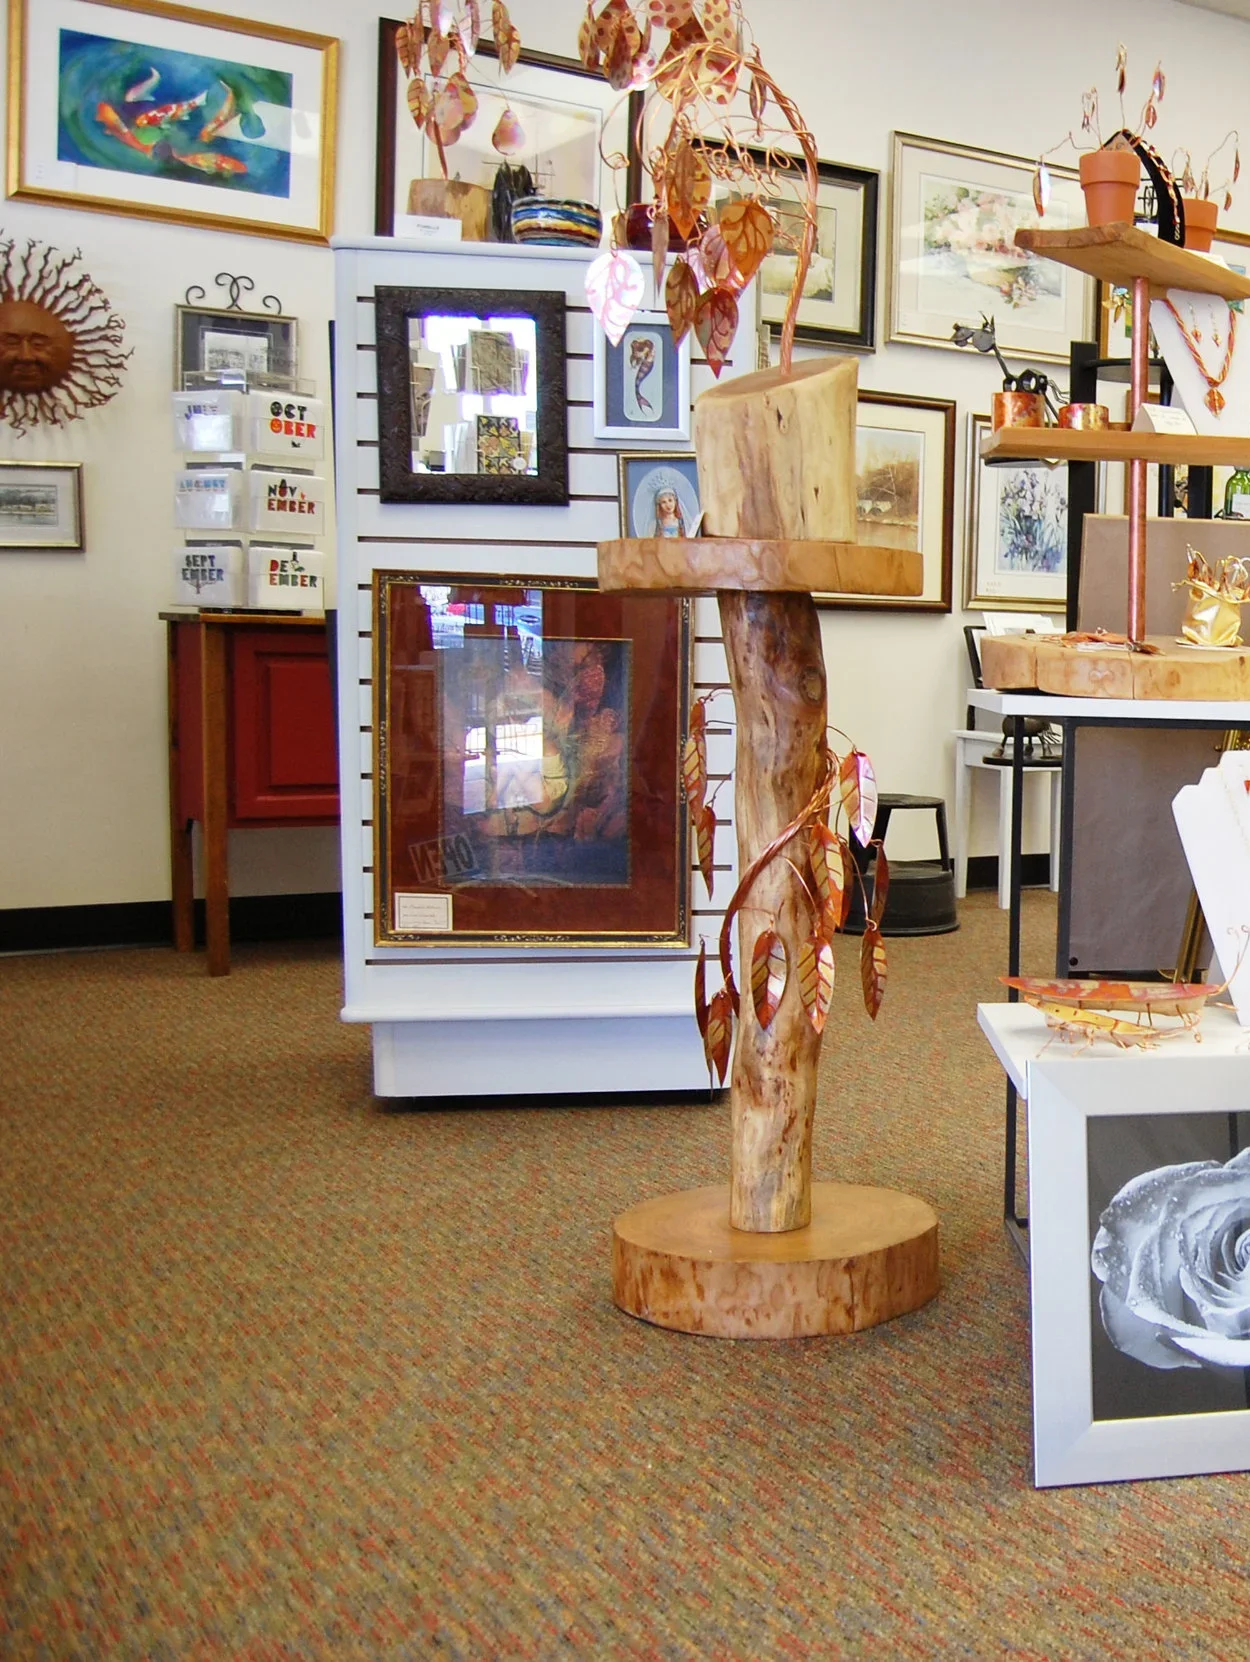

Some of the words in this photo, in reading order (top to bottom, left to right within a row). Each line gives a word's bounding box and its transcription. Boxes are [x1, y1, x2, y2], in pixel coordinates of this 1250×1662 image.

[269, 401, 308, 419] OCT
[270, 418, 316, 439] OBER
[268, 479, 297, 497] NOV
[267, 498, 315, 514] EMBER
[185, 554, 215, 567] SEPT
[181, 568, 224, 581] EMBER
[269, 573, 317, 588] EMBER
